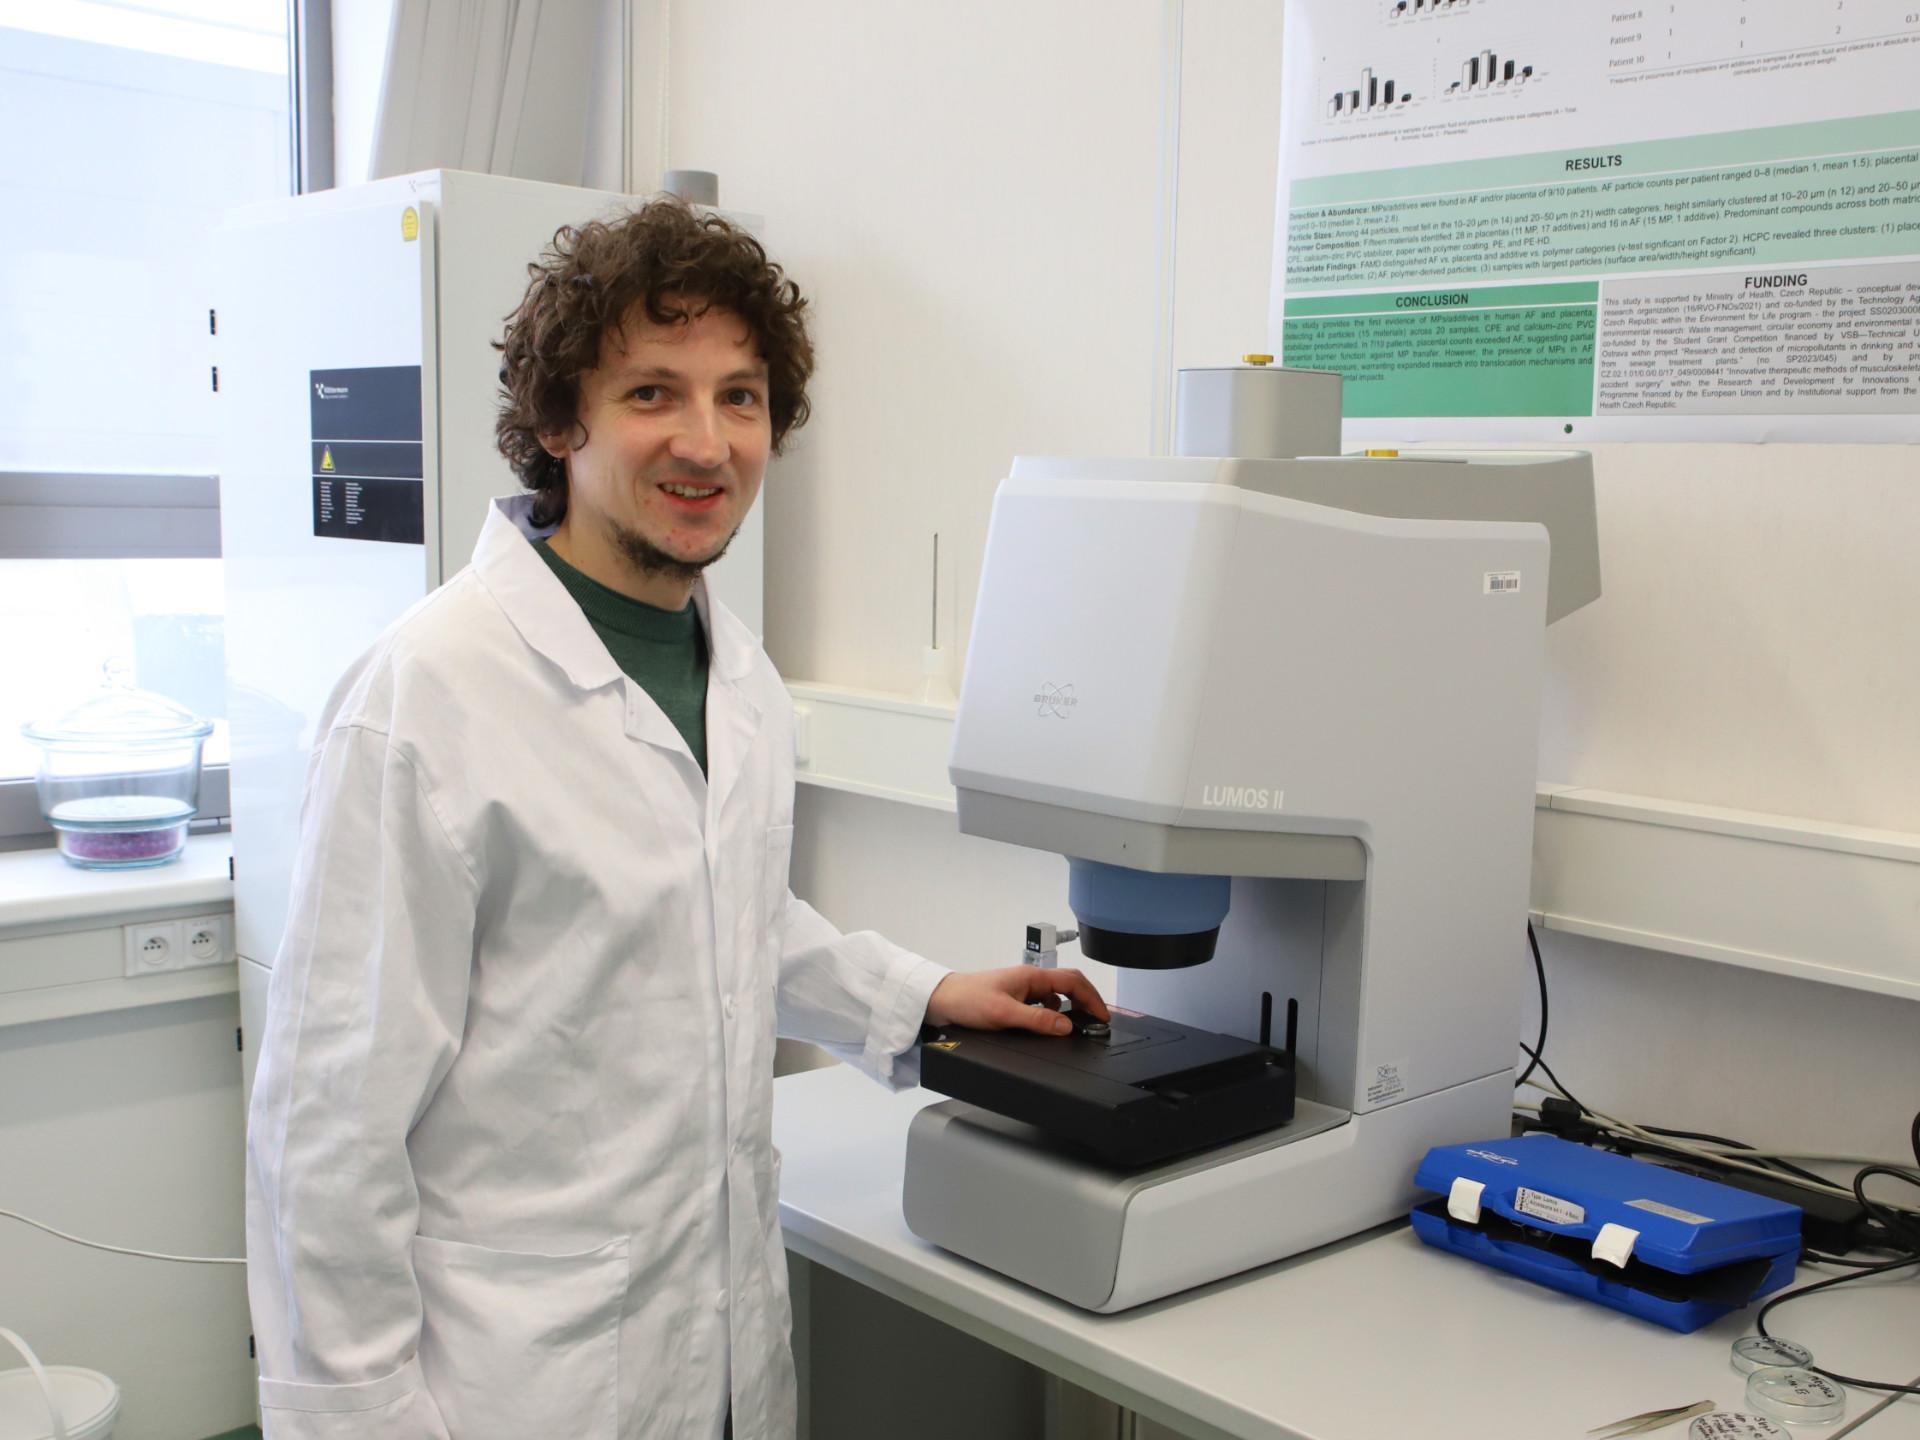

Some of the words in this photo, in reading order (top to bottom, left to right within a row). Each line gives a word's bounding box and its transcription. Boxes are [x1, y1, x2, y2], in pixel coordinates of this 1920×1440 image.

[1611, 12, 1636, 23] Patient
[1610, 34, 1635, 46] Patient
[1609, 56, 1634, 68] Patient
[1565, 154, 1622, 171] RESULTS
[1875, 153, 1918, 168] placental
[1675, 177, 1688, 187] per
[1721, 169, 1751, 181] ranged
[1773, 164, 1808, 178] (median
[1822, 161, 1848, 171] mean
[1857, 183, 1875, 194] and
[1664, 200, 1689, 211] height
[1723, 205, 1777, 218] Predominant
[1780, 201, 1832, 214] compounds
[1835, 199, 1866, 209] across
[1868, 196, 1889, 206] both
[1700, 235, 1726, 245] Factor
[1772, 228, 1810, 239] revealed
[1813, 227, 1836, 236] three
[1880, 222, 1894, 234] (1)
[1744, 273, 1808, 289] FUNDING
[1808, 285, 1843, 297] Republic
[1856, 282, 1901, 294] conceptual
[1395, 292, 1469, 308] CONCLUSION
[1764, 300, 1779, 308] and
[1859, 294, 1904, 304] Technology
[1540, 310, 1556, 318] and
[1779, 311, 1811, 321] program
[1822, 308, 1835, 317] the
[1838, 307, 1866, 318] project
[1576, 320, 1594, 328] PVC
[1897, 339, 1913, 348] and
[1202, 784, 1269, 809] LUMOS
[1272, 789, 1285, 810] II
